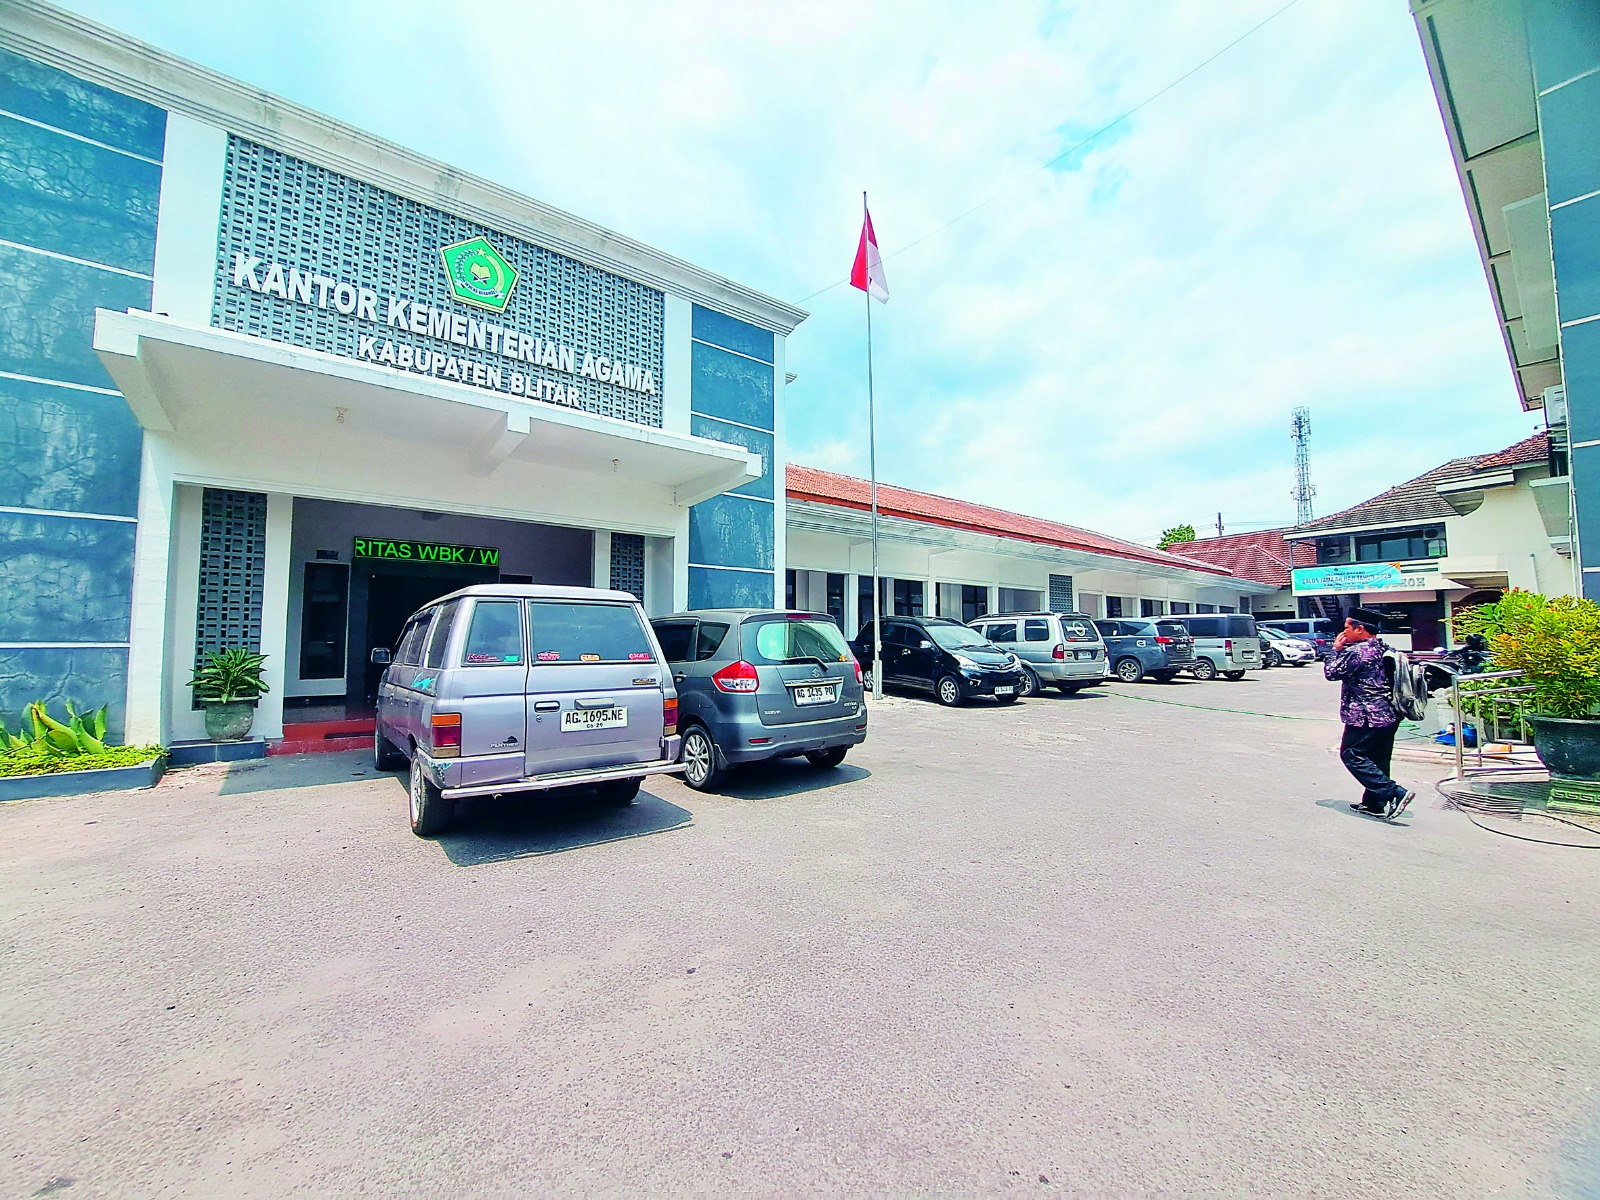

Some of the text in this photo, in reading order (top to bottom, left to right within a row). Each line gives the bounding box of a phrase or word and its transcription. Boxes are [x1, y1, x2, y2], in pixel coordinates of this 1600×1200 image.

[233, 252, 656, 395] KANTOR KEMENTERIAN AGAMA
[359, 335, 580, 406] KABUPATEN BLITAR
[356, 540, 412, 558] RITAS
[418, 545, 464, 562] WBK
[469, 549, 475, 562] /
